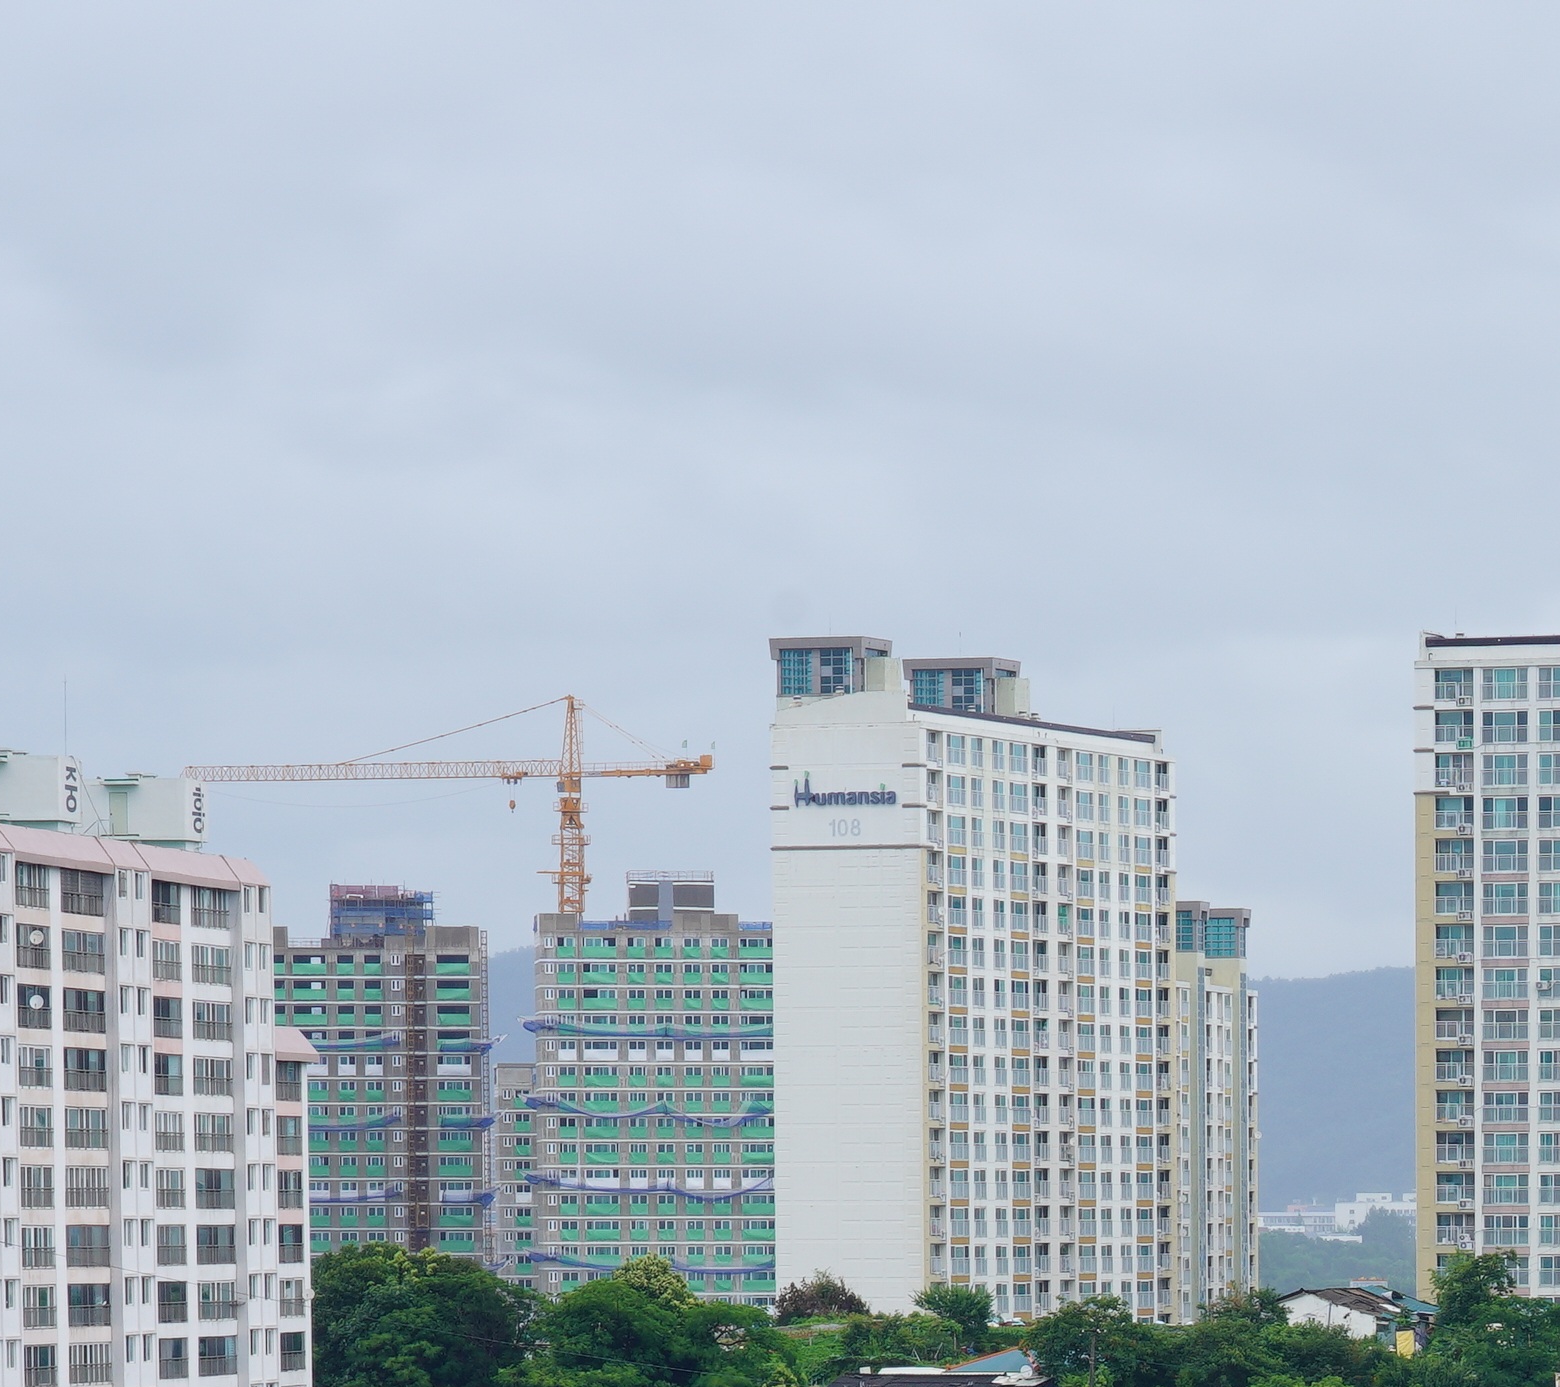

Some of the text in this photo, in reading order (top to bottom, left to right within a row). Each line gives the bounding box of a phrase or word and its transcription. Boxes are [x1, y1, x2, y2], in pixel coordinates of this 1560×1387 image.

[64, 766, 78, 813] 중
[793, 770, 897, 808] Humansia
[829, 819, 861, 837] 108
